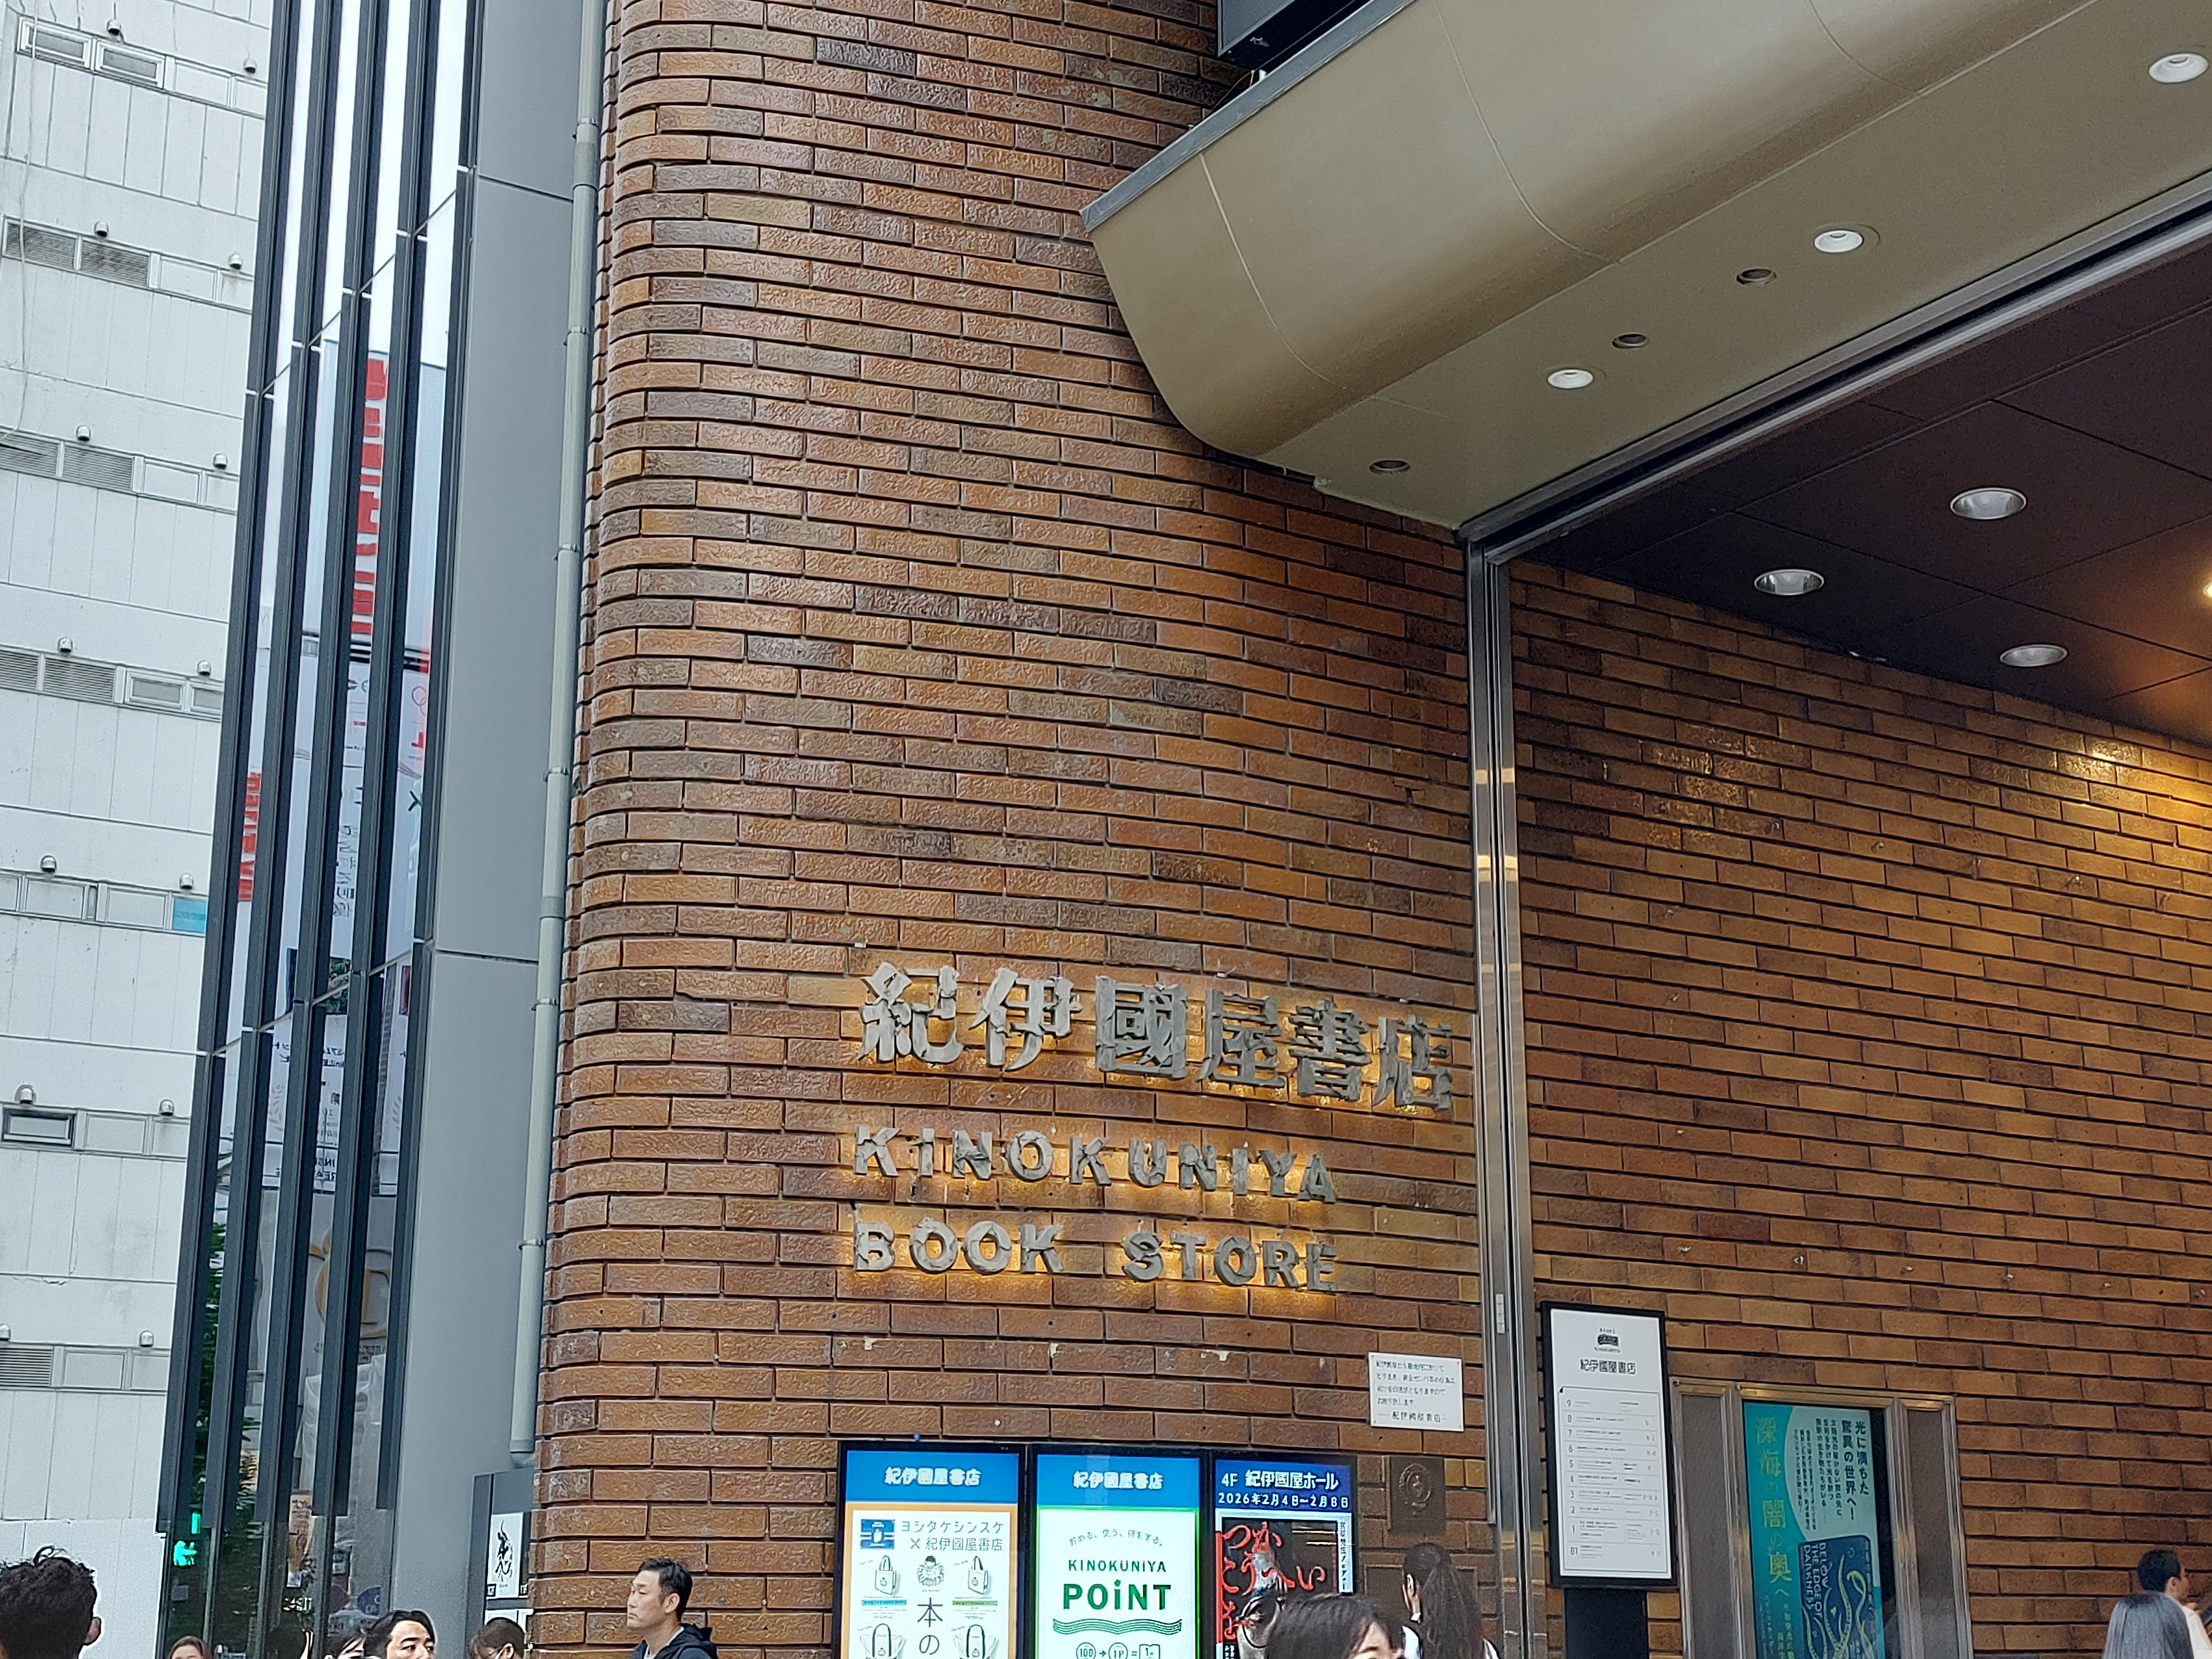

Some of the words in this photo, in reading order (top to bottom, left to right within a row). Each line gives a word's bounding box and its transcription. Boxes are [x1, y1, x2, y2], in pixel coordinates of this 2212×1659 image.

[859, 962, 1454, 1113] 紀伊國屋書店
[854, 1125, 1336, 1204] KINOKUNIYA
[853, 1218, 1063, 1275] BOOK
[1122, 1231, 1338, 1292] STORE
[1855, 1420, 1869, 1495] 光に満ちた
[885, 1466, 982, 1486] 紀伊國屋書店
[1073, 1471, 1163, 1490] 紀伊國屋書店
[1221, 1472, 1239, 1486] 4F
[1245, 1469, 1339, 1491] 紀伊國屋ホール
[901, 1520, 1005, 1534] ヨシタケシンスケ
[925, 1537, 1003, 1551] 紀伊國屋書店
[1068, 1559, 1166, 1572] KINOKUNIYA
[917, 1597, 943, 1655] 本の
